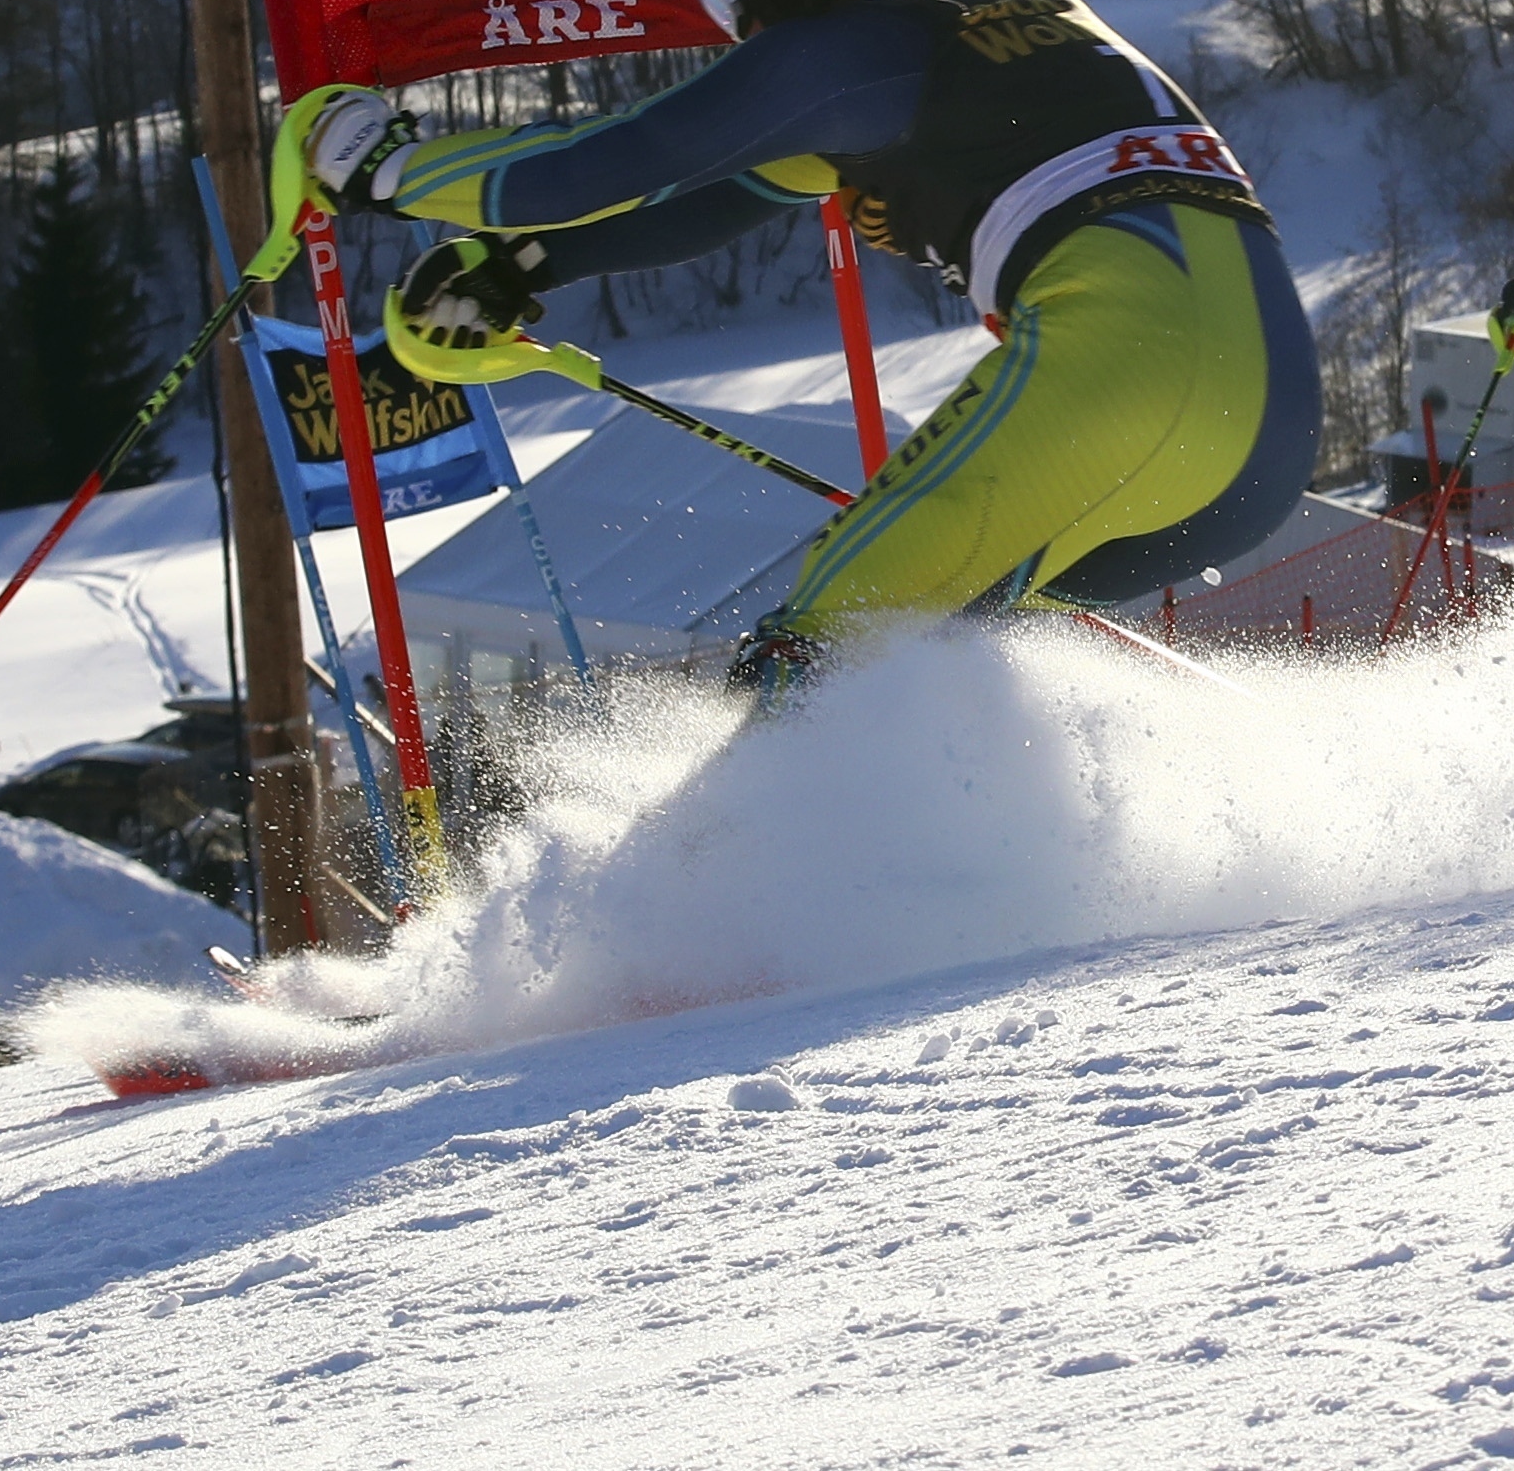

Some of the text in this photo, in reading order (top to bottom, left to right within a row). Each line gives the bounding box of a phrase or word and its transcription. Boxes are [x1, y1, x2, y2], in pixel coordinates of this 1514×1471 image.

[1107, 132, 1252, 185] ÅR
[137, 353, 196, 425] LEKI
[287, 363, 395, 419] Jak
[291, 385, 467, 457] Wlfskin
[689, 421, 774, 467] LEKI
[385, 480, 437, 513] RE
